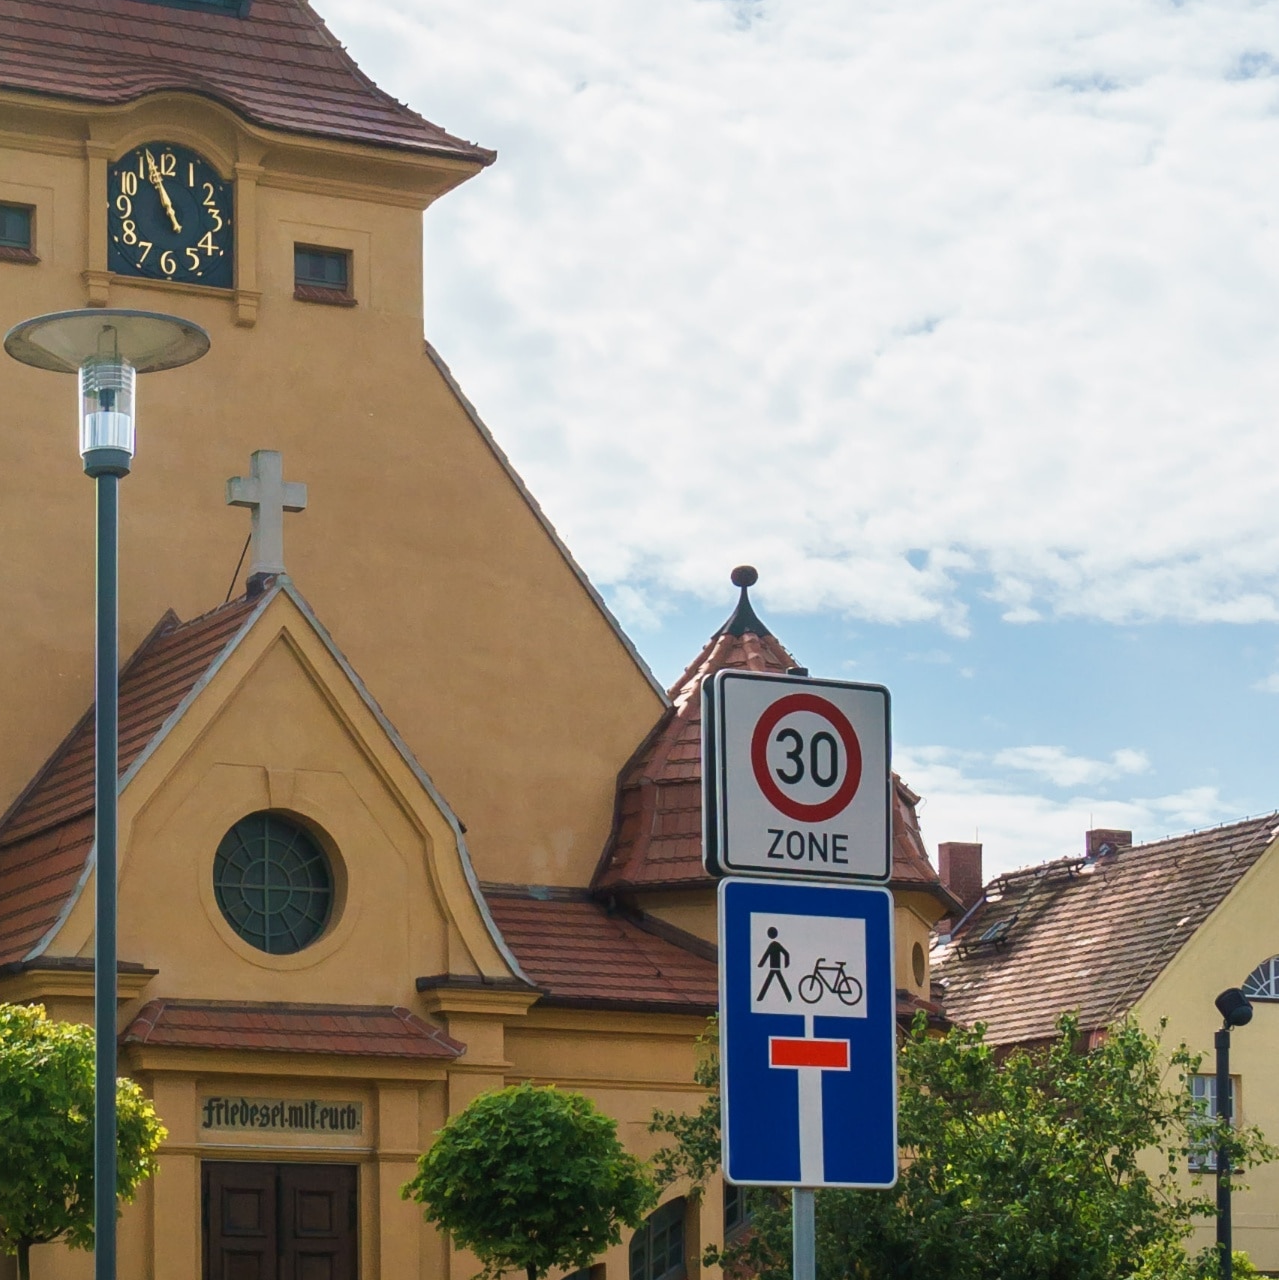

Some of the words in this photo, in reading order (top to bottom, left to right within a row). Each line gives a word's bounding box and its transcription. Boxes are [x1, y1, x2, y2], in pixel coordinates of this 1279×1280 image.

[160, 154, 176, 176] 12
[188, 163, 194, 187] 1
[122, 171, 137, 196] 10
[202, 182, 215, 206] 2
[116, 194, 132, 219] 9
[122, 219, 137, 245] 8
[207, 208, 223, 232] 3
[138, 242, 152, 263] 7
[197, 231, 219, 256] 4
[160, 251, 176, 274] 6
[186, 247, 200, 270] 5
[776, 728, 838, 787] 30
[767, 828, 849, 864] ZONE
